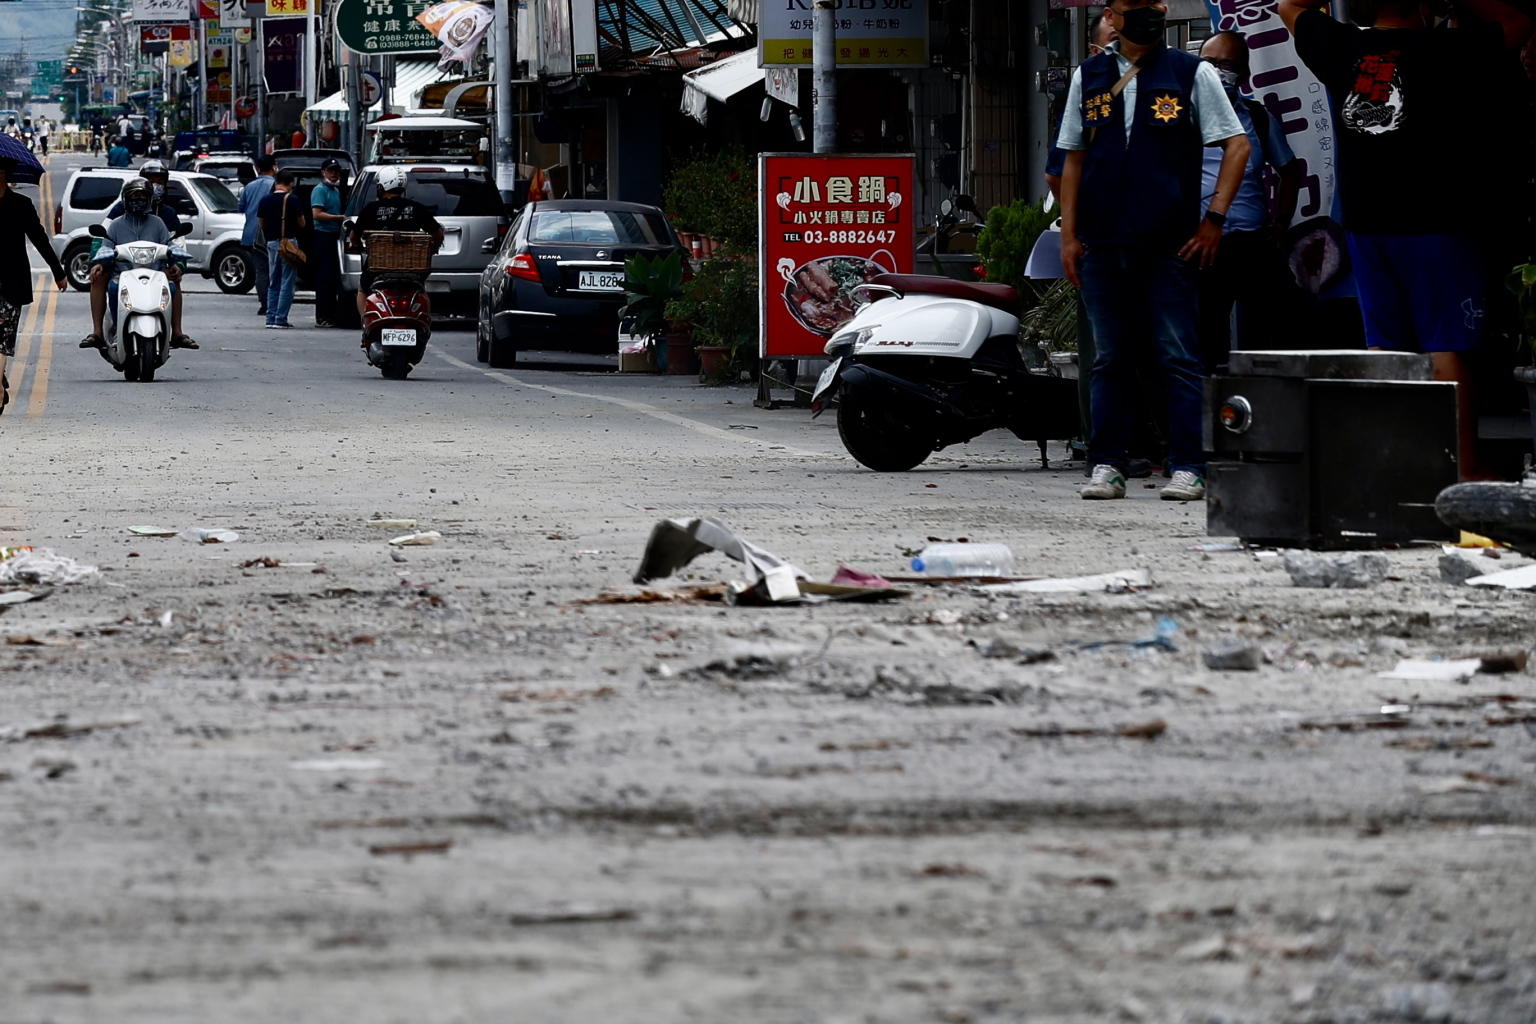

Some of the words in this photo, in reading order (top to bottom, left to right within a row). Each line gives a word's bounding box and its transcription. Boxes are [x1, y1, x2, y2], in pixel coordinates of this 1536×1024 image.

[793, 176, 886, 204] 小食鍋
[793, 210, 886, 224] 小火鍋專賣店
[784, 233, 800, 242] TEL
[804, 230, 896, 244] 03-8882647
